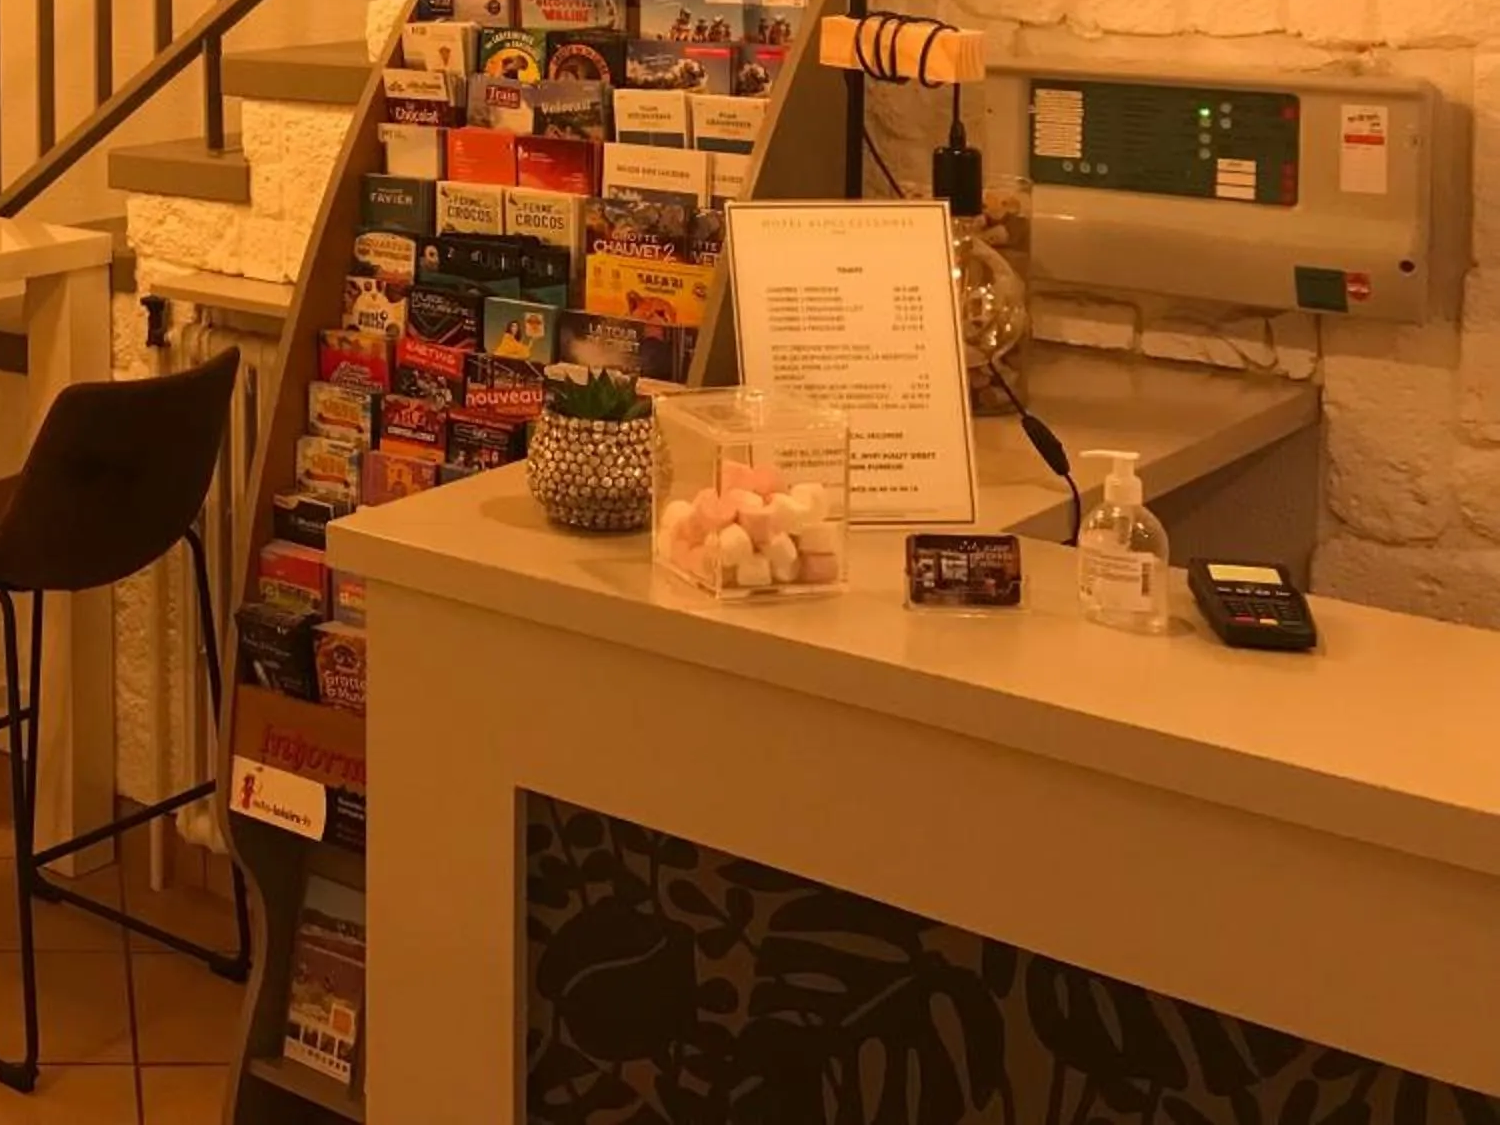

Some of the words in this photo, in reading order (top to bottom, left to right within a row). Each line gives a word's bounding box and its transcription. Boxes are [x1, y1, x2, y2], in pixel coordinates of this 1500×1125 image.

[447, 205, 493, 223] CROCOS
[515, 214, 565, 230] CROCOS
[593, 239, 662, 259] CHAUVET
[465, 390, 543, 407] nouveau
